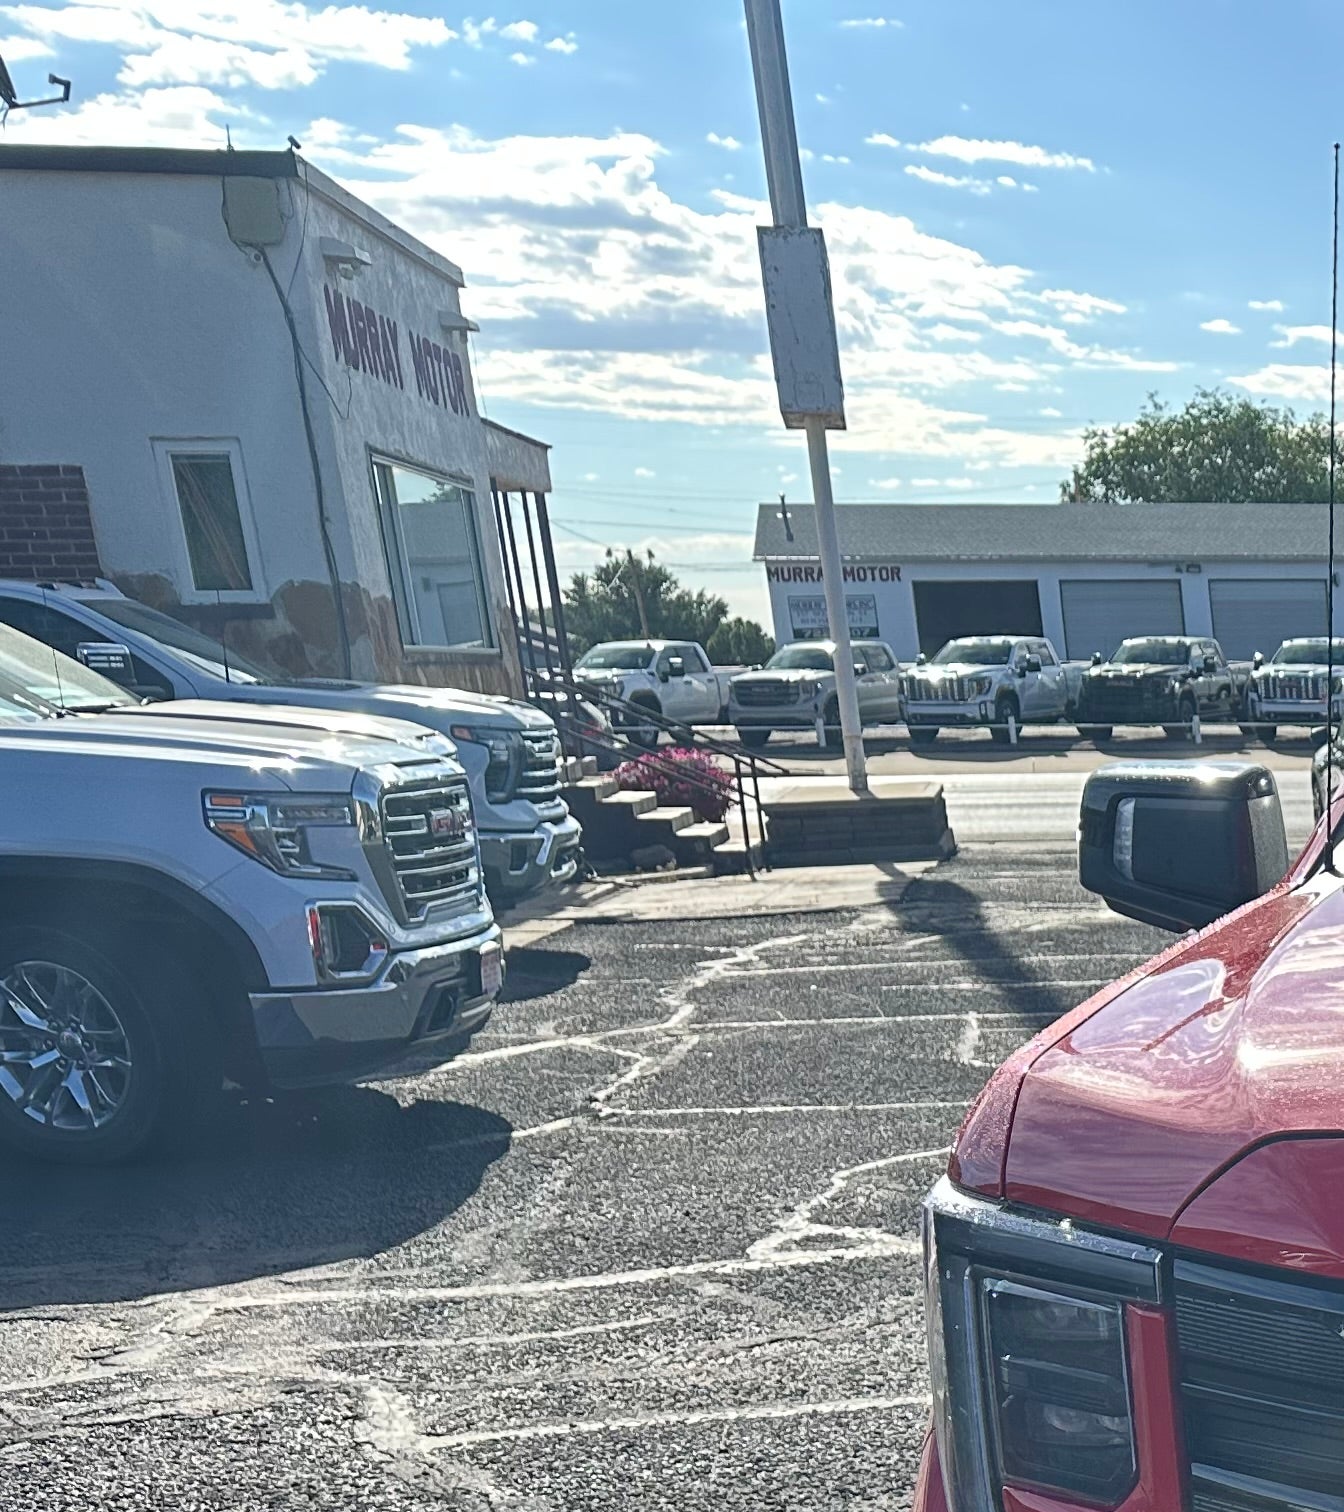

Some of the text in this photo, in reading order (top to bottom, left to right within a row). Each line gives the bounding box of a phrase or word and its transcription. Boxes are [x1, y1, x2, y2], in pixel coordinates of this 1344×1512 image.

[323, 283, 470, 417] MURRAY MOTOR
[767, 565, 902, 583] MURRA MOTOR
